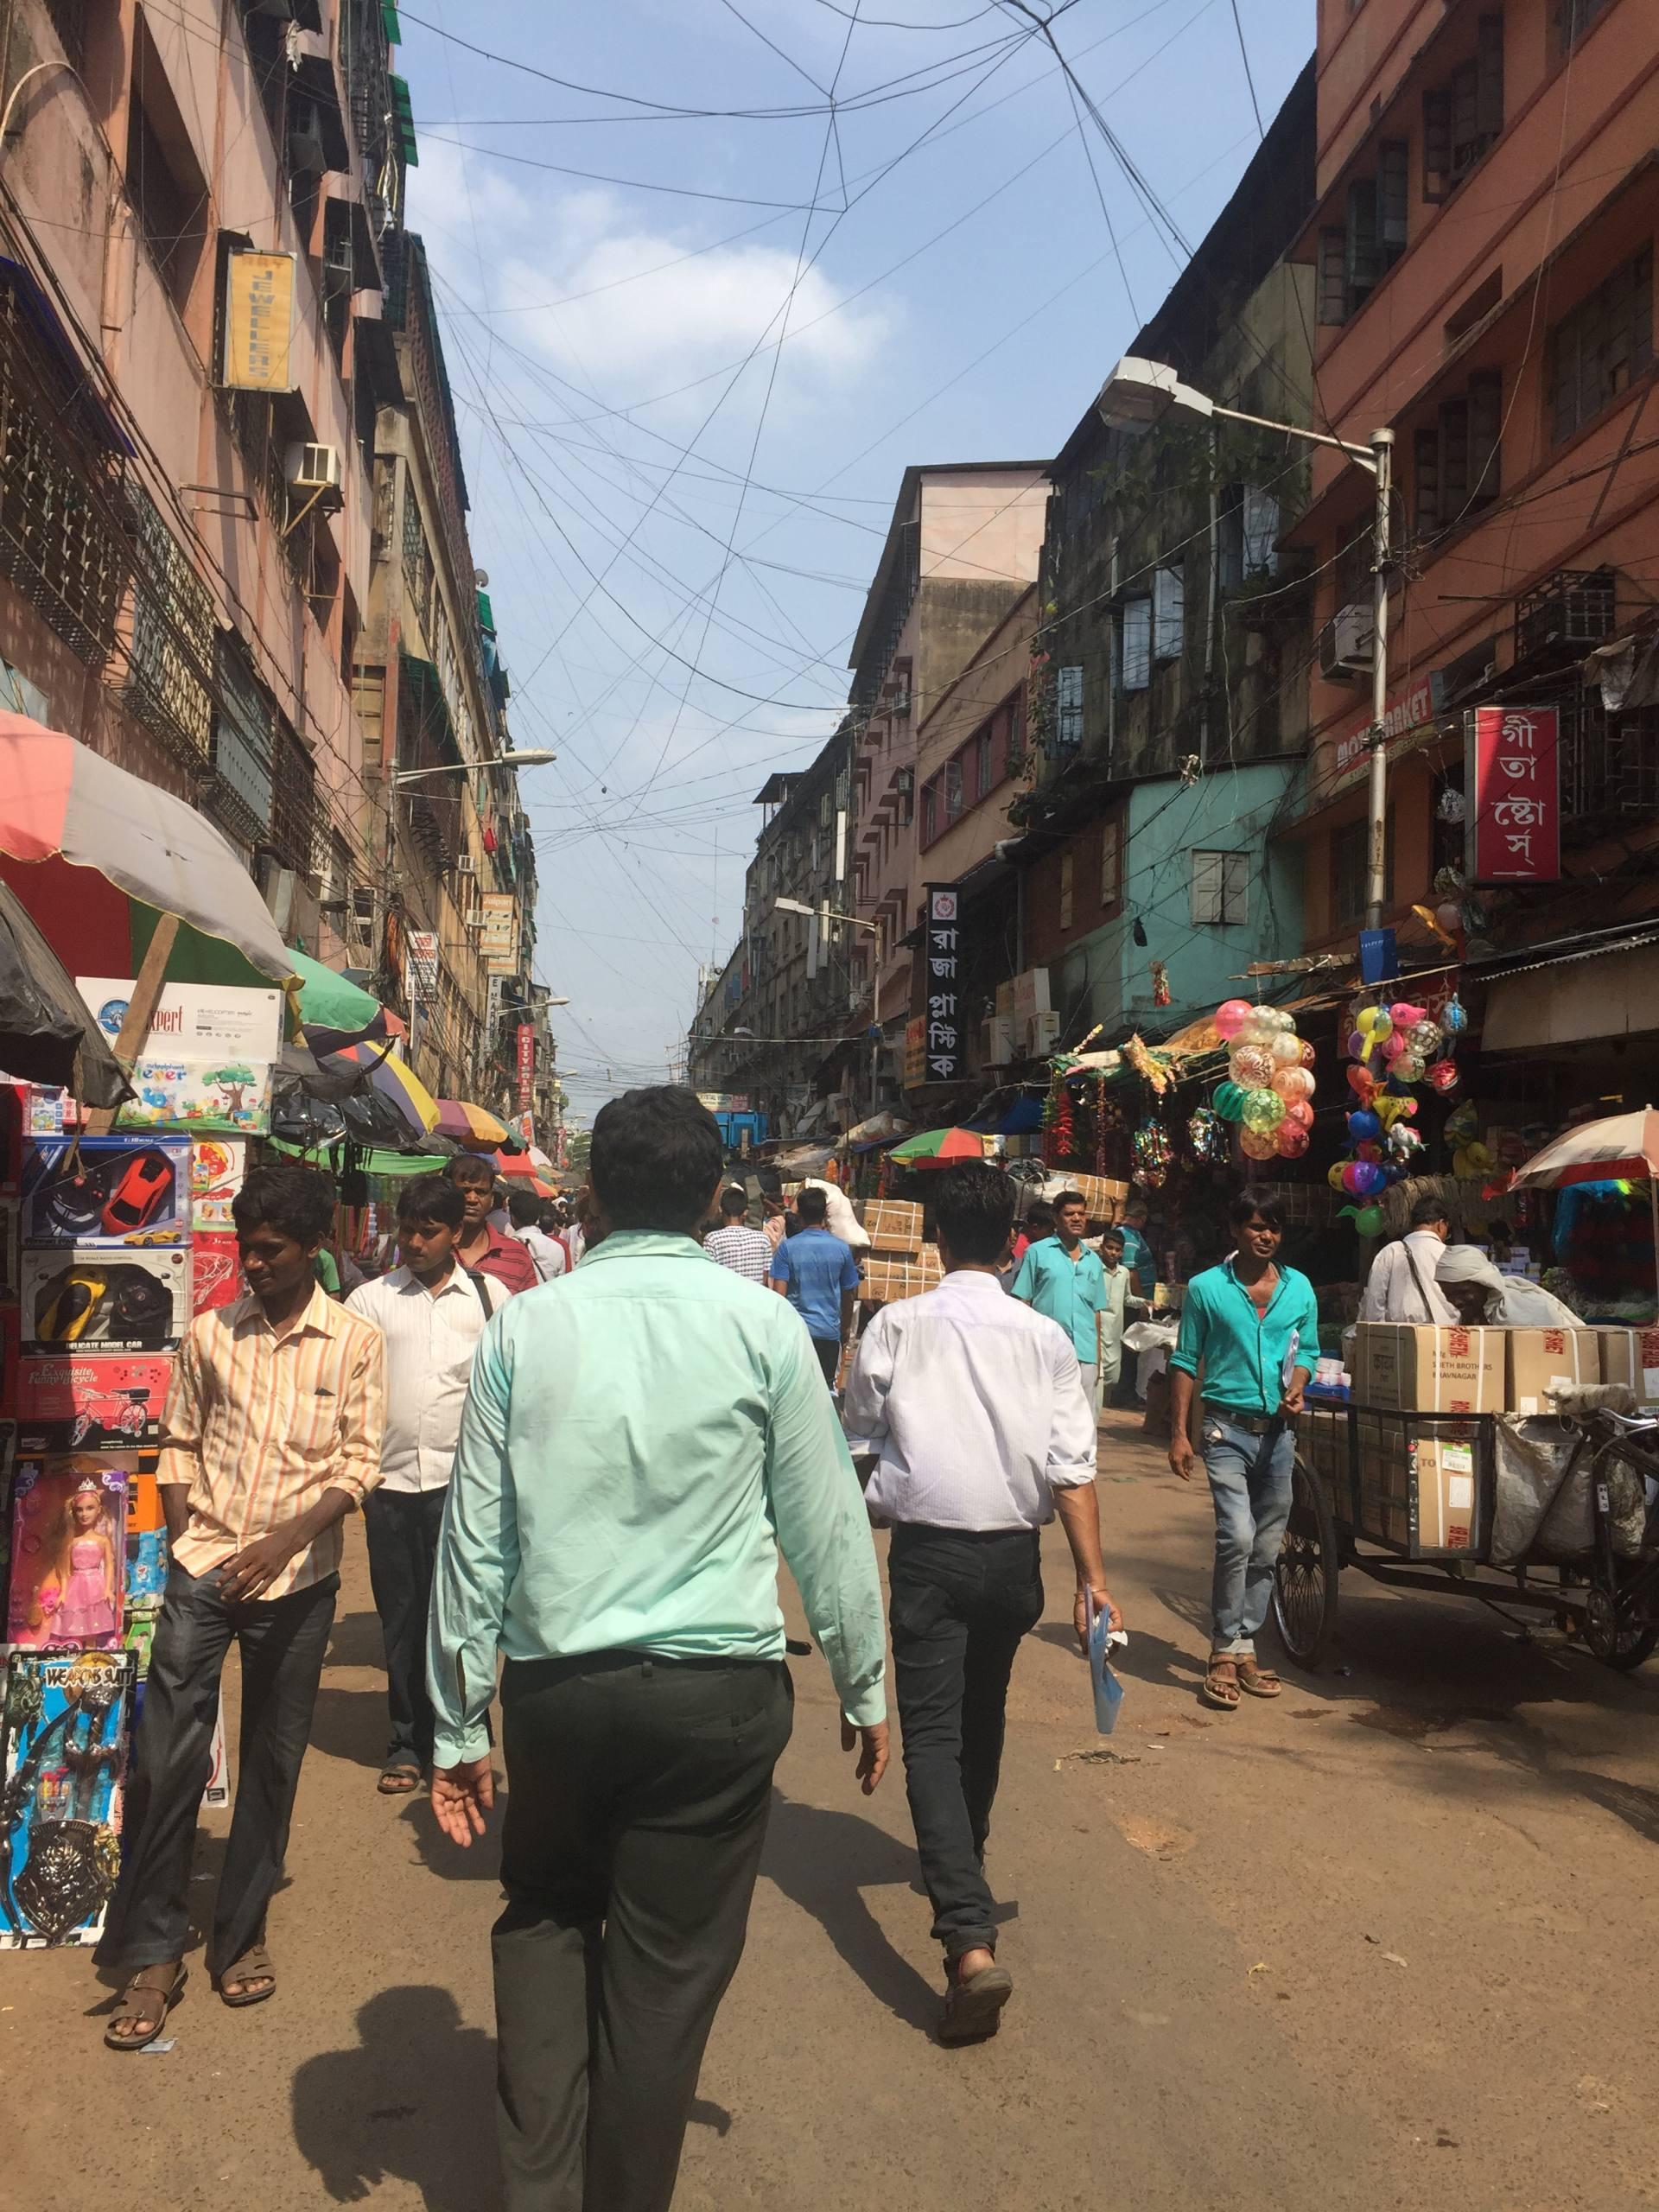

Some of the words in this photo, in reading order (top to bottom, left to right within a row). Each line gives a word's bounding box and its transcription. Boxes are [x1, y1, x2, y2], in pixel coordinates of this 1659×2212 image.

[249, 270, 276, 378] JEWELLERS
[1383, 687, 1428, 741] ARKET
[147, 1006, 184, 1033] xpert
[521, 1037, 531, 1064] CITY
[41, 1363, 93, 1377] Exquisite
